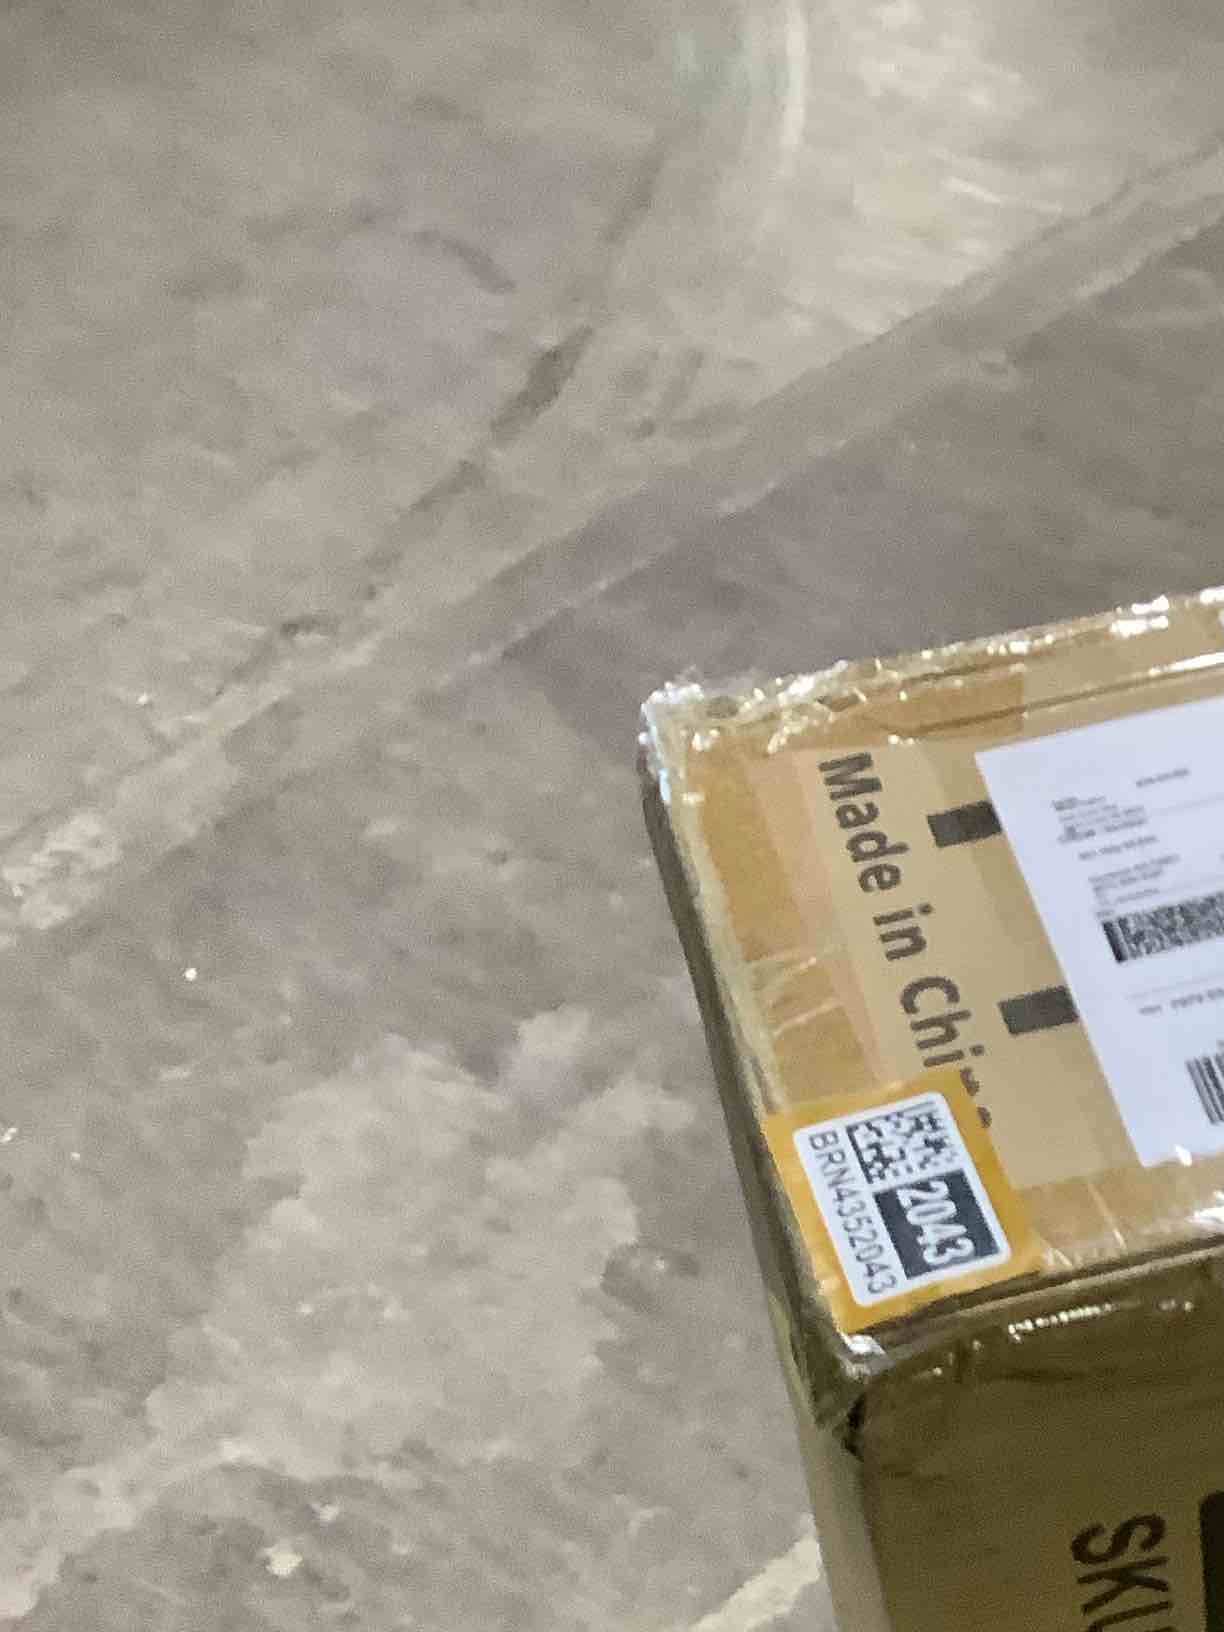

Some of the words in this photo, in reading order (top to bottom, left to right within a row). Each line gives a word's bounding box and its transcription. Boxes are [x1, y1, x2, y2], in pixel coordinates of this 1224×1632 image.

[818, 752, 910, 893] Made
[873, 903, 934, 961] in
[901, 976, 992, 1129] Chi
[808, 1130, 897, 1295] BRN4352043
[897, 1180, 975, 1266] 2043
